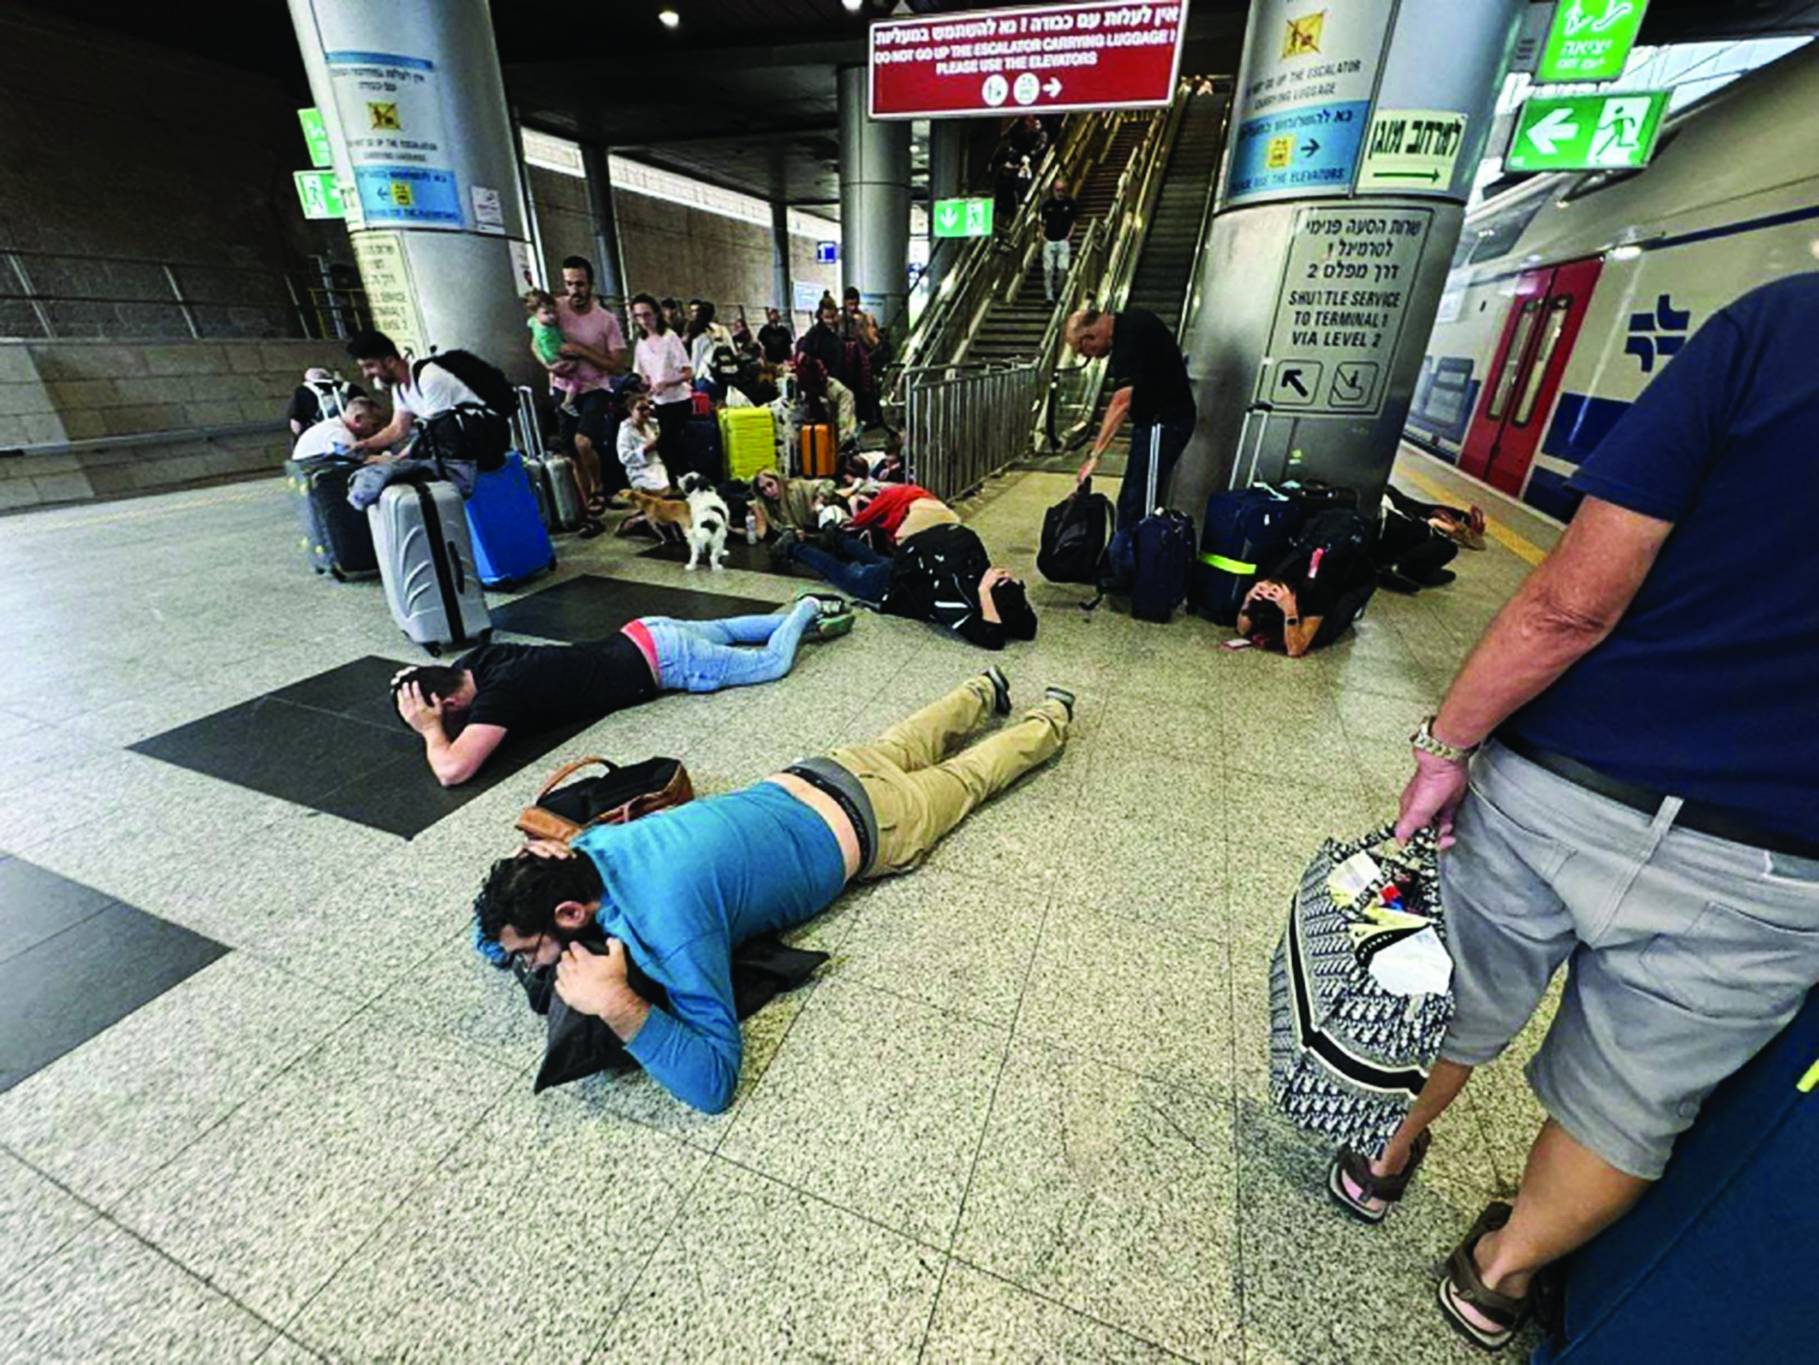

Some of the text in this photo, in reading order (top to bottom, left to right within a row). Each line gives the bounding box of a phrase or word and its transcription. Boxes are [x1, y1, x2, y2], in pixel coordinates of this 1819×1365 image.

[1030, 15, 1074, 31] כבודה
[1077, 12, 1101, 29] עם
[1104, 5, 1152, 26] לעלות
[1154, 6, 1179, 27] אין
[932, 18, 997, 40] להשתמש
[998, 19, 1017, 34] נא
[875, 28, 930, 45] במעליות
[874, 52, 890, 64] DO
[891, 49, 914, 63] NOT
[915, 47, 933, 61] GO
[934, 46, 950, 60] UP
[950, 44, 973, 57] THE
[974, 38, 1042, 56] ESCALATOR
[1043, 33, 1105, 50] CARRYING
[1106, 29, 1168, 47] LUGGAGE
[936, 51, 1098, 75] PLEASE USE THE ELEVATORS
[1368, 118, 1462, 160] למרחב מוגן
[1291, 167, 1344, 183] ELEVATORS
[1306, 218, 1422, 237] שרות הסעה פנימי
[1337, 238, 1394, 257] לטרמינל
[1307, 261, 1401, 283] דרך מפלס 2
[1289, 291, 1402, 308] SHUTTLE SERVICE
[1294, 311, 1388, 328] TO TERMINAL 1
[1292, 331, 1382, 348] VIA LEVEL 2
